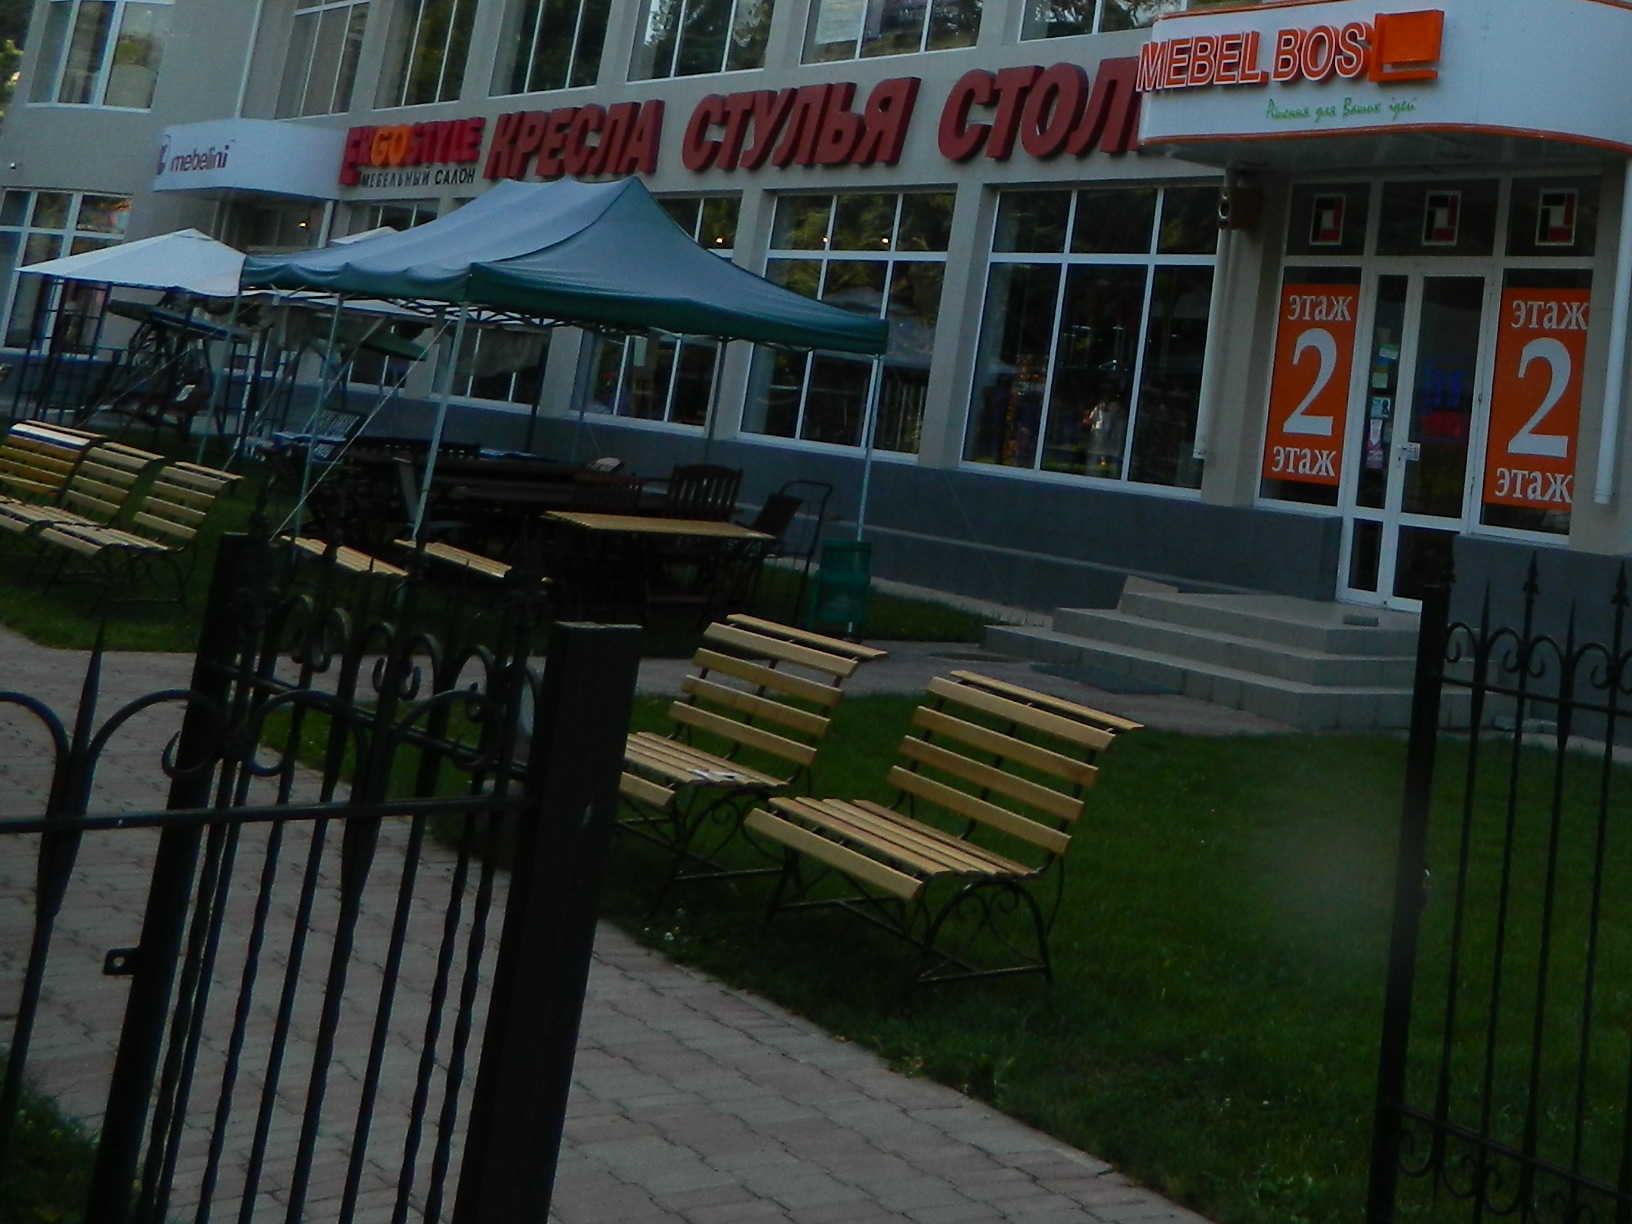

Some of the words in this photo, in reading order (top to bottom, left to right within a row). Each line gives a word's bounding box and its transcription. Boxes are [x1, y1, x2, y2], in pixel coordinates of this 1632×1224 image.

[1135, 30, 1266, 93] MEBEL
[1272, 21, 1372, 84] BOS
[338, 116, 487, 187] ERGOSTYLE
[482, 98, 666, 180] КРЕСЛА
[681, 77, 922, 172] СТУЛЬЯ
[937, 56, 1146, 162] СТОЛ
[360, 166, 431, 188] МЕБЕЛЬНЫЙ
[434, 167, 476, 186] САЛОН
[1282, 327, 1338, 437] 2
[1507, 336, 1572, 459] 2
